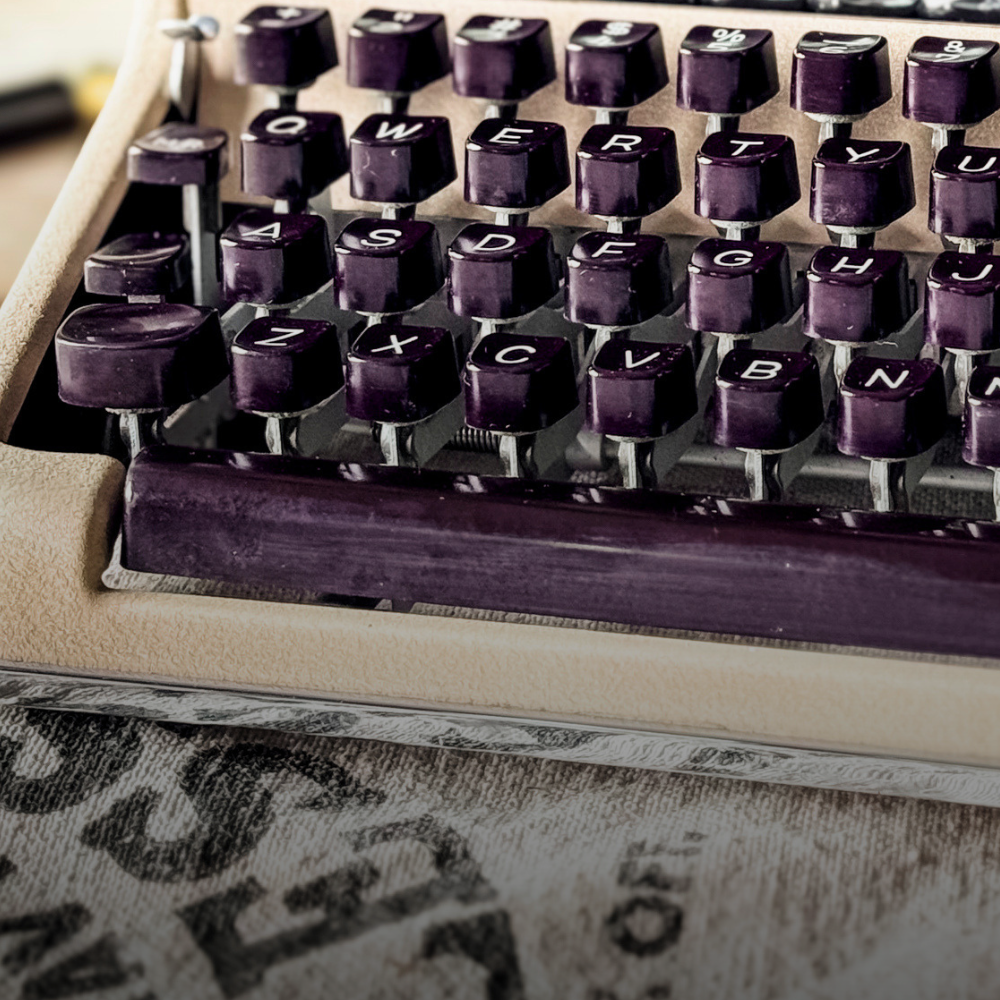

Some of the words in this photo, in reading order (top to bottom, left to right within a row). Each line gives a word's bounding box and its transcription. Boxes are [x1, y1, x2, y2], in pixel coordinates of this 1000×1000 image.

[601, 20, 634, 36] $
[711, 28, 746, 43] %
[699, 42, 733, 52] 5
[943, 40, 967, 53] &
[266, 115, 307, 135] Q
[375, 121, 423, 140] W
[489, 127, 534, 145] E
[601, 134, 642, 152] R
[730, 140, 764, 156] T
[845, 146, 880, 163] Y
[957, 155, 997, 172] U
[242, 222, 281, 242] A
[360, 228, 402, 248] S
[472, 233, 515, 252] D
[591, 241, 637, 258] F
[713, 249, 754, 267] G
[830, 256, 873, 275] H
[951, 264, 993, 281] J
[253, 327, 305, 347] Z
[371, 334, 419, 355] X
[494, 345, 537, 364] C
[625, 349, 661, 369] V
[740, 359, 783, 380] B
[864, 368, 910, 389] N
